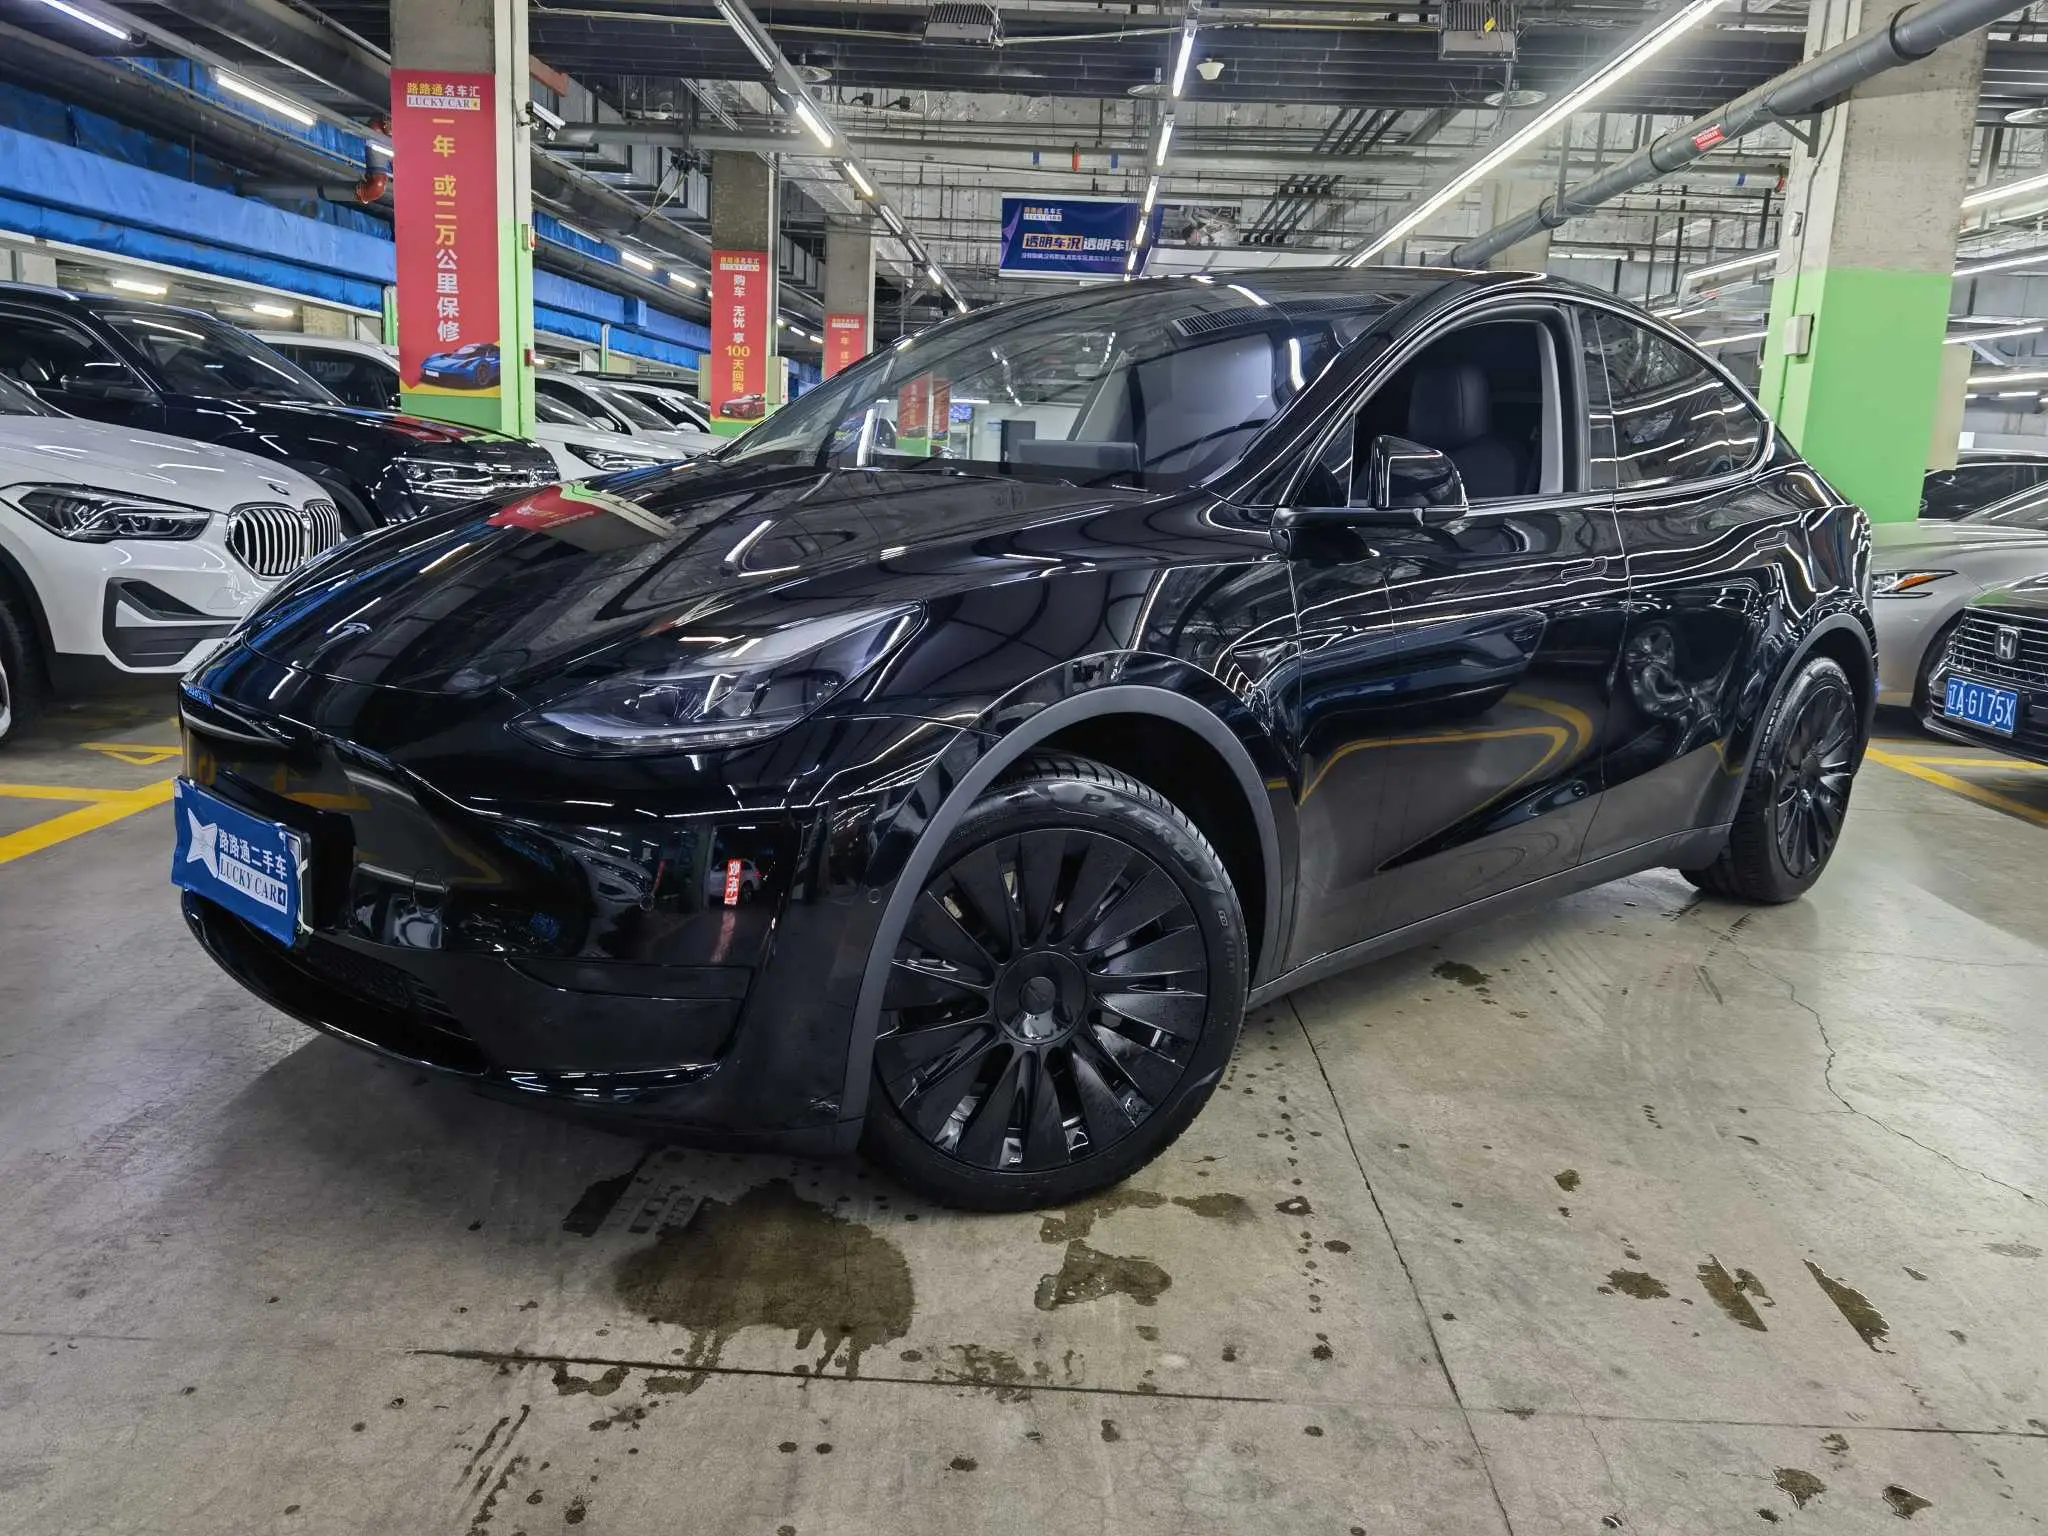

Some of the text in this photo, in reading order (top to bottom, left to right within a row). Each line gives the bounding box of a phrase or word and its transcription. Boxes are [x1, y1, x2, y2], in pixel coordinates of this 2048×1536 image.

[407, 82, 480, 97] 路路通名车汇
[408, 96, 470, 108] LUCKY CAR
[218, 828, 288, 881] 路路通二手车
[220, 858, 278, 904] LUCKY CAR
